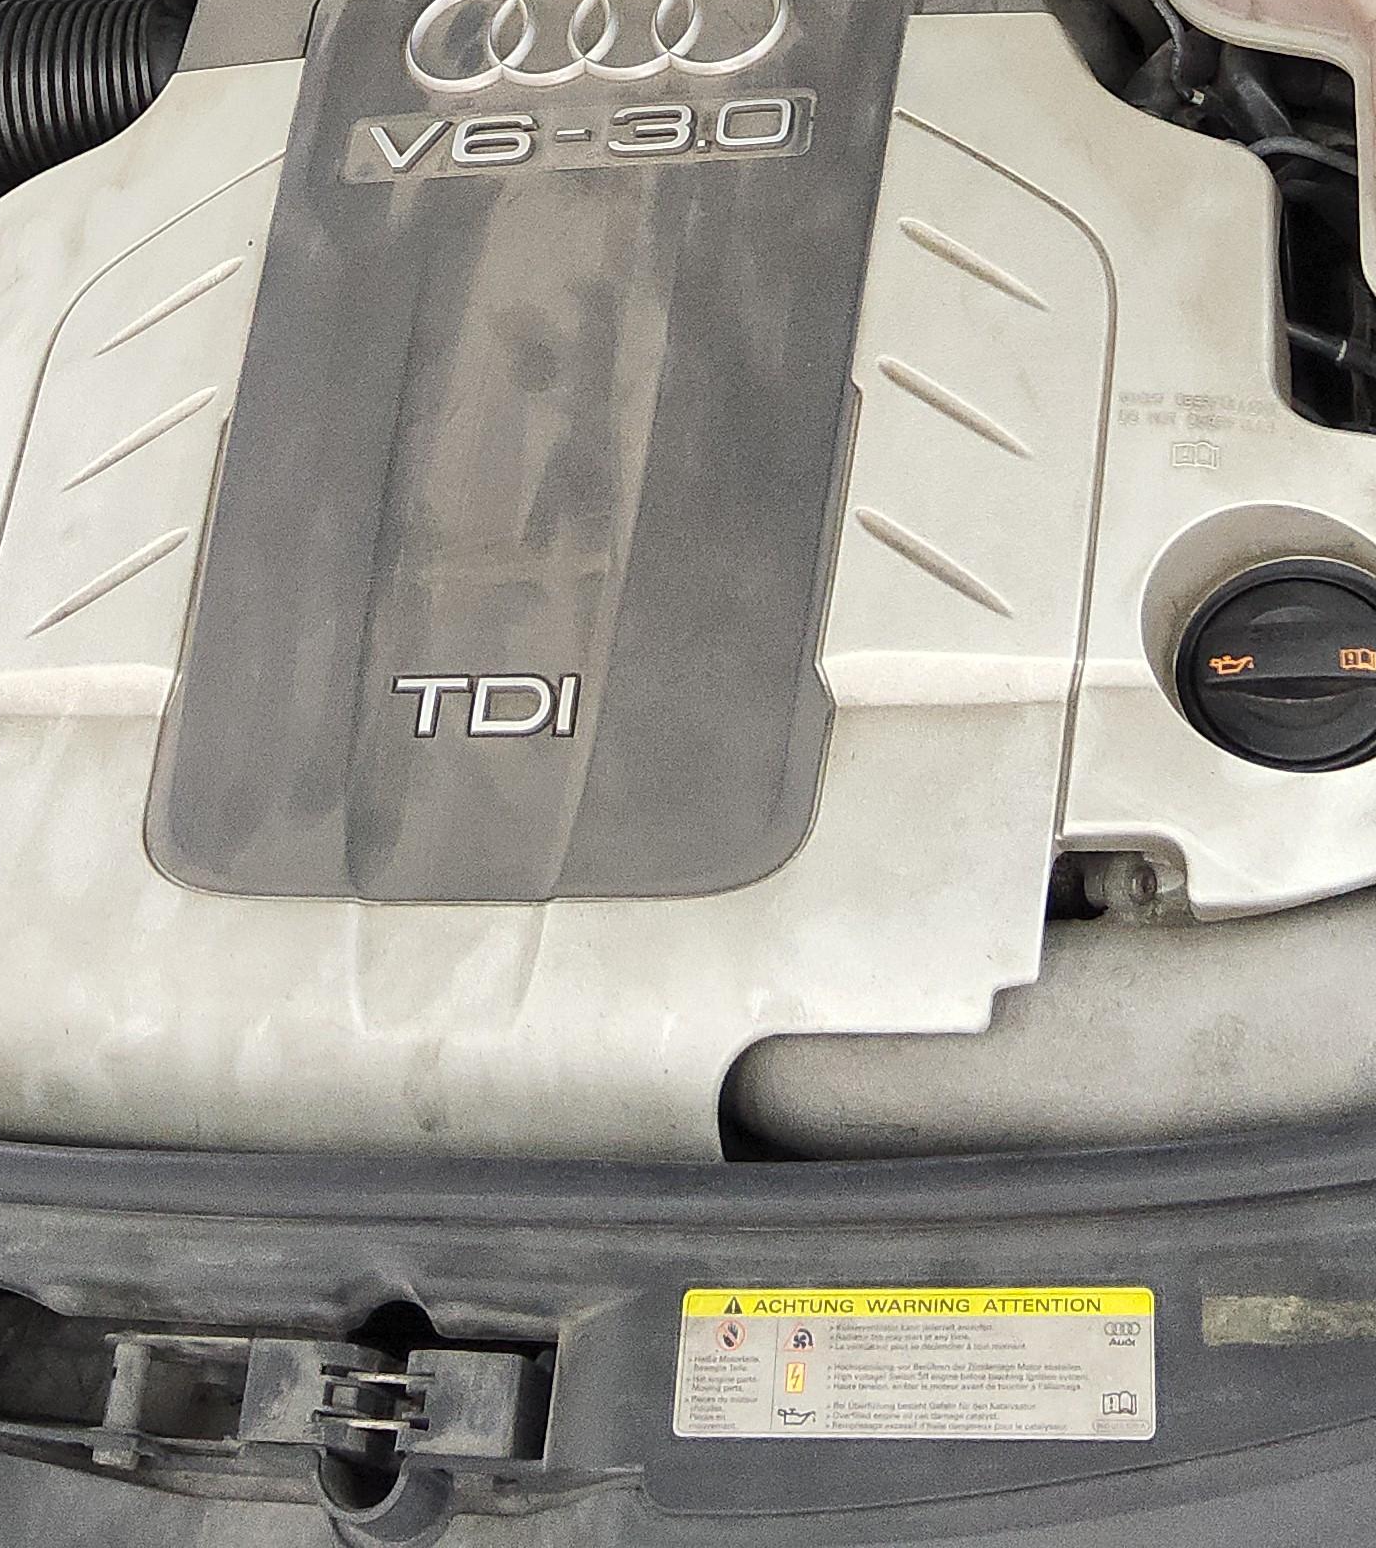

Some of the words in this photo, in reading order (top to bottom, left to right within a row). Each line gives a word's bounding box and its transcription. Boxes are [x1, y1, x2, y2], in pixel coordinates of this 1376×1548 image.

[391, 673, 582, 738] TDI
[753, 1297, 855, 1314] ACHTUNG
[866, 1297, 971, 1314] WARNING
[984, 1297, 1102, 1313] ATTENTION
[1108, 1337, 1136, 1348] Audi
